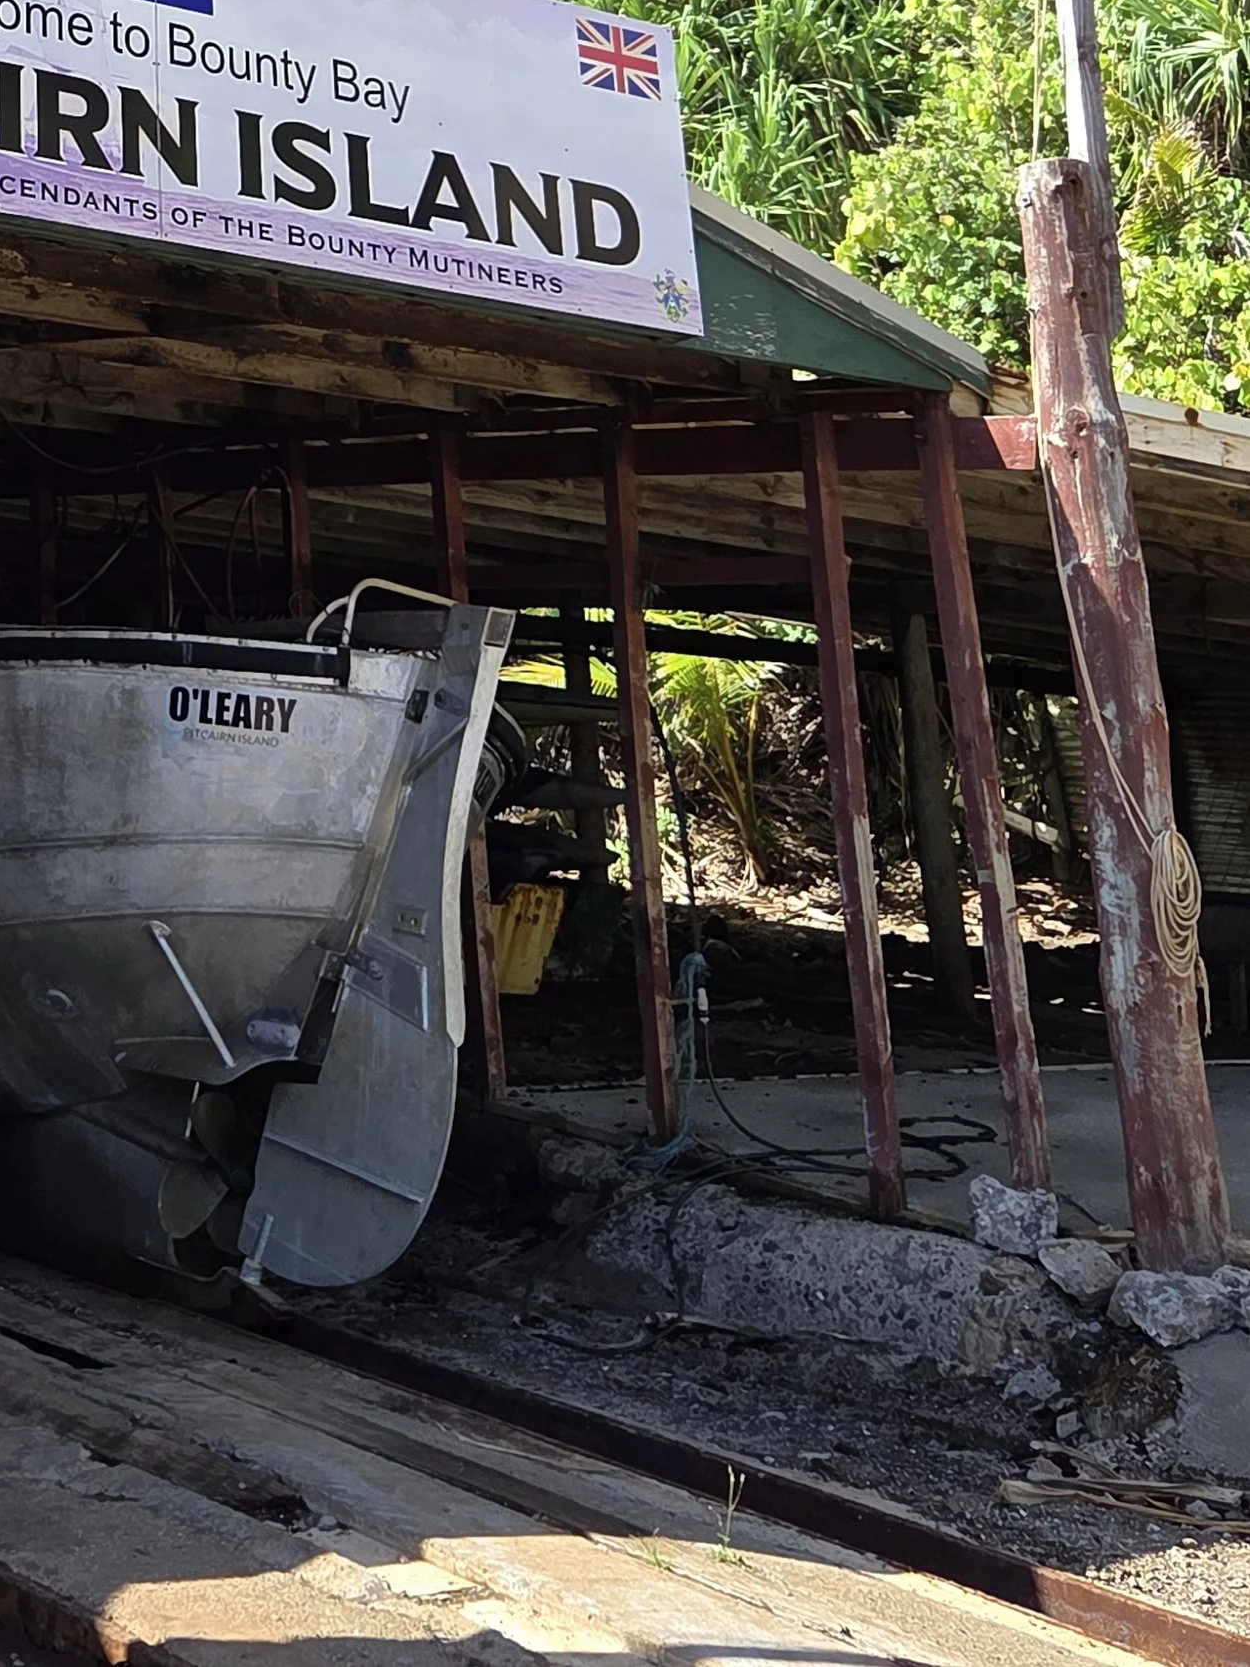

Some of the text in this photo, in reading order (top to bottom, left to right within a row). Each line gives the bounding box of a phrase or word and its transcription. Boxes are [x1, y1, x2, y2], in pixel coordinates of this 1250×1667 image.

[110, 12, 151, 58] to
[169, 23, 316, 103] Bounty
[333, 60, 410, 122] Bay
[234, 109, 641, 266] ISLAND
[171, 205, 207, 227] OF
[218, 216, 274, 242] THE
[287, 225, 397, 263] BOUNTY
[408, 247, 563, 294] MUTINEERS
[169, 686, 297, 733] O'LEARY
